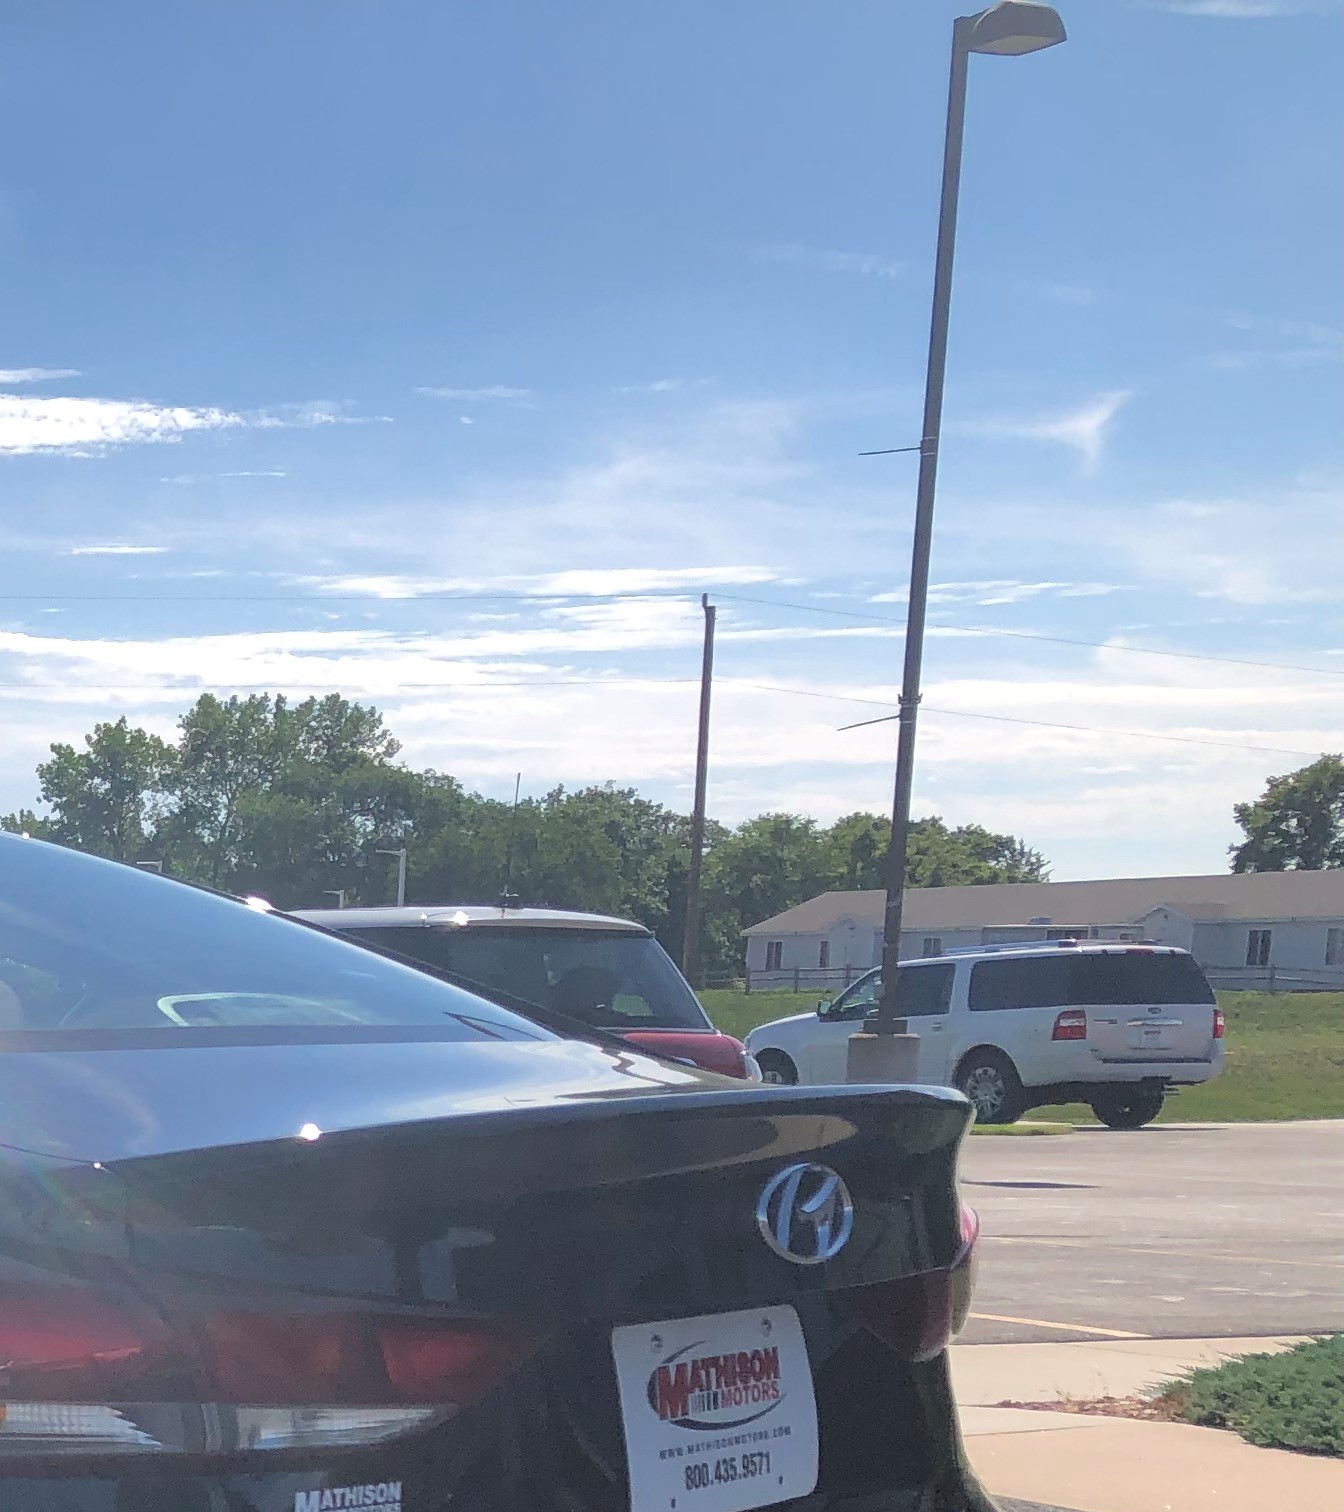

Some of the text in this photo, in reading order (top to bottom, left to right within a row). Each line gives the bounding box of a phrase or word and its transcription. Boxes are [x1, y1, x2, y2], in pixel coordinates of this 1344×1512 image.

[658, 1346, 780, 1420] MATHISON
[721, 1381, 780, 1409] MOTORS
[684, 1451, 771, 1491] 800.435.9571
